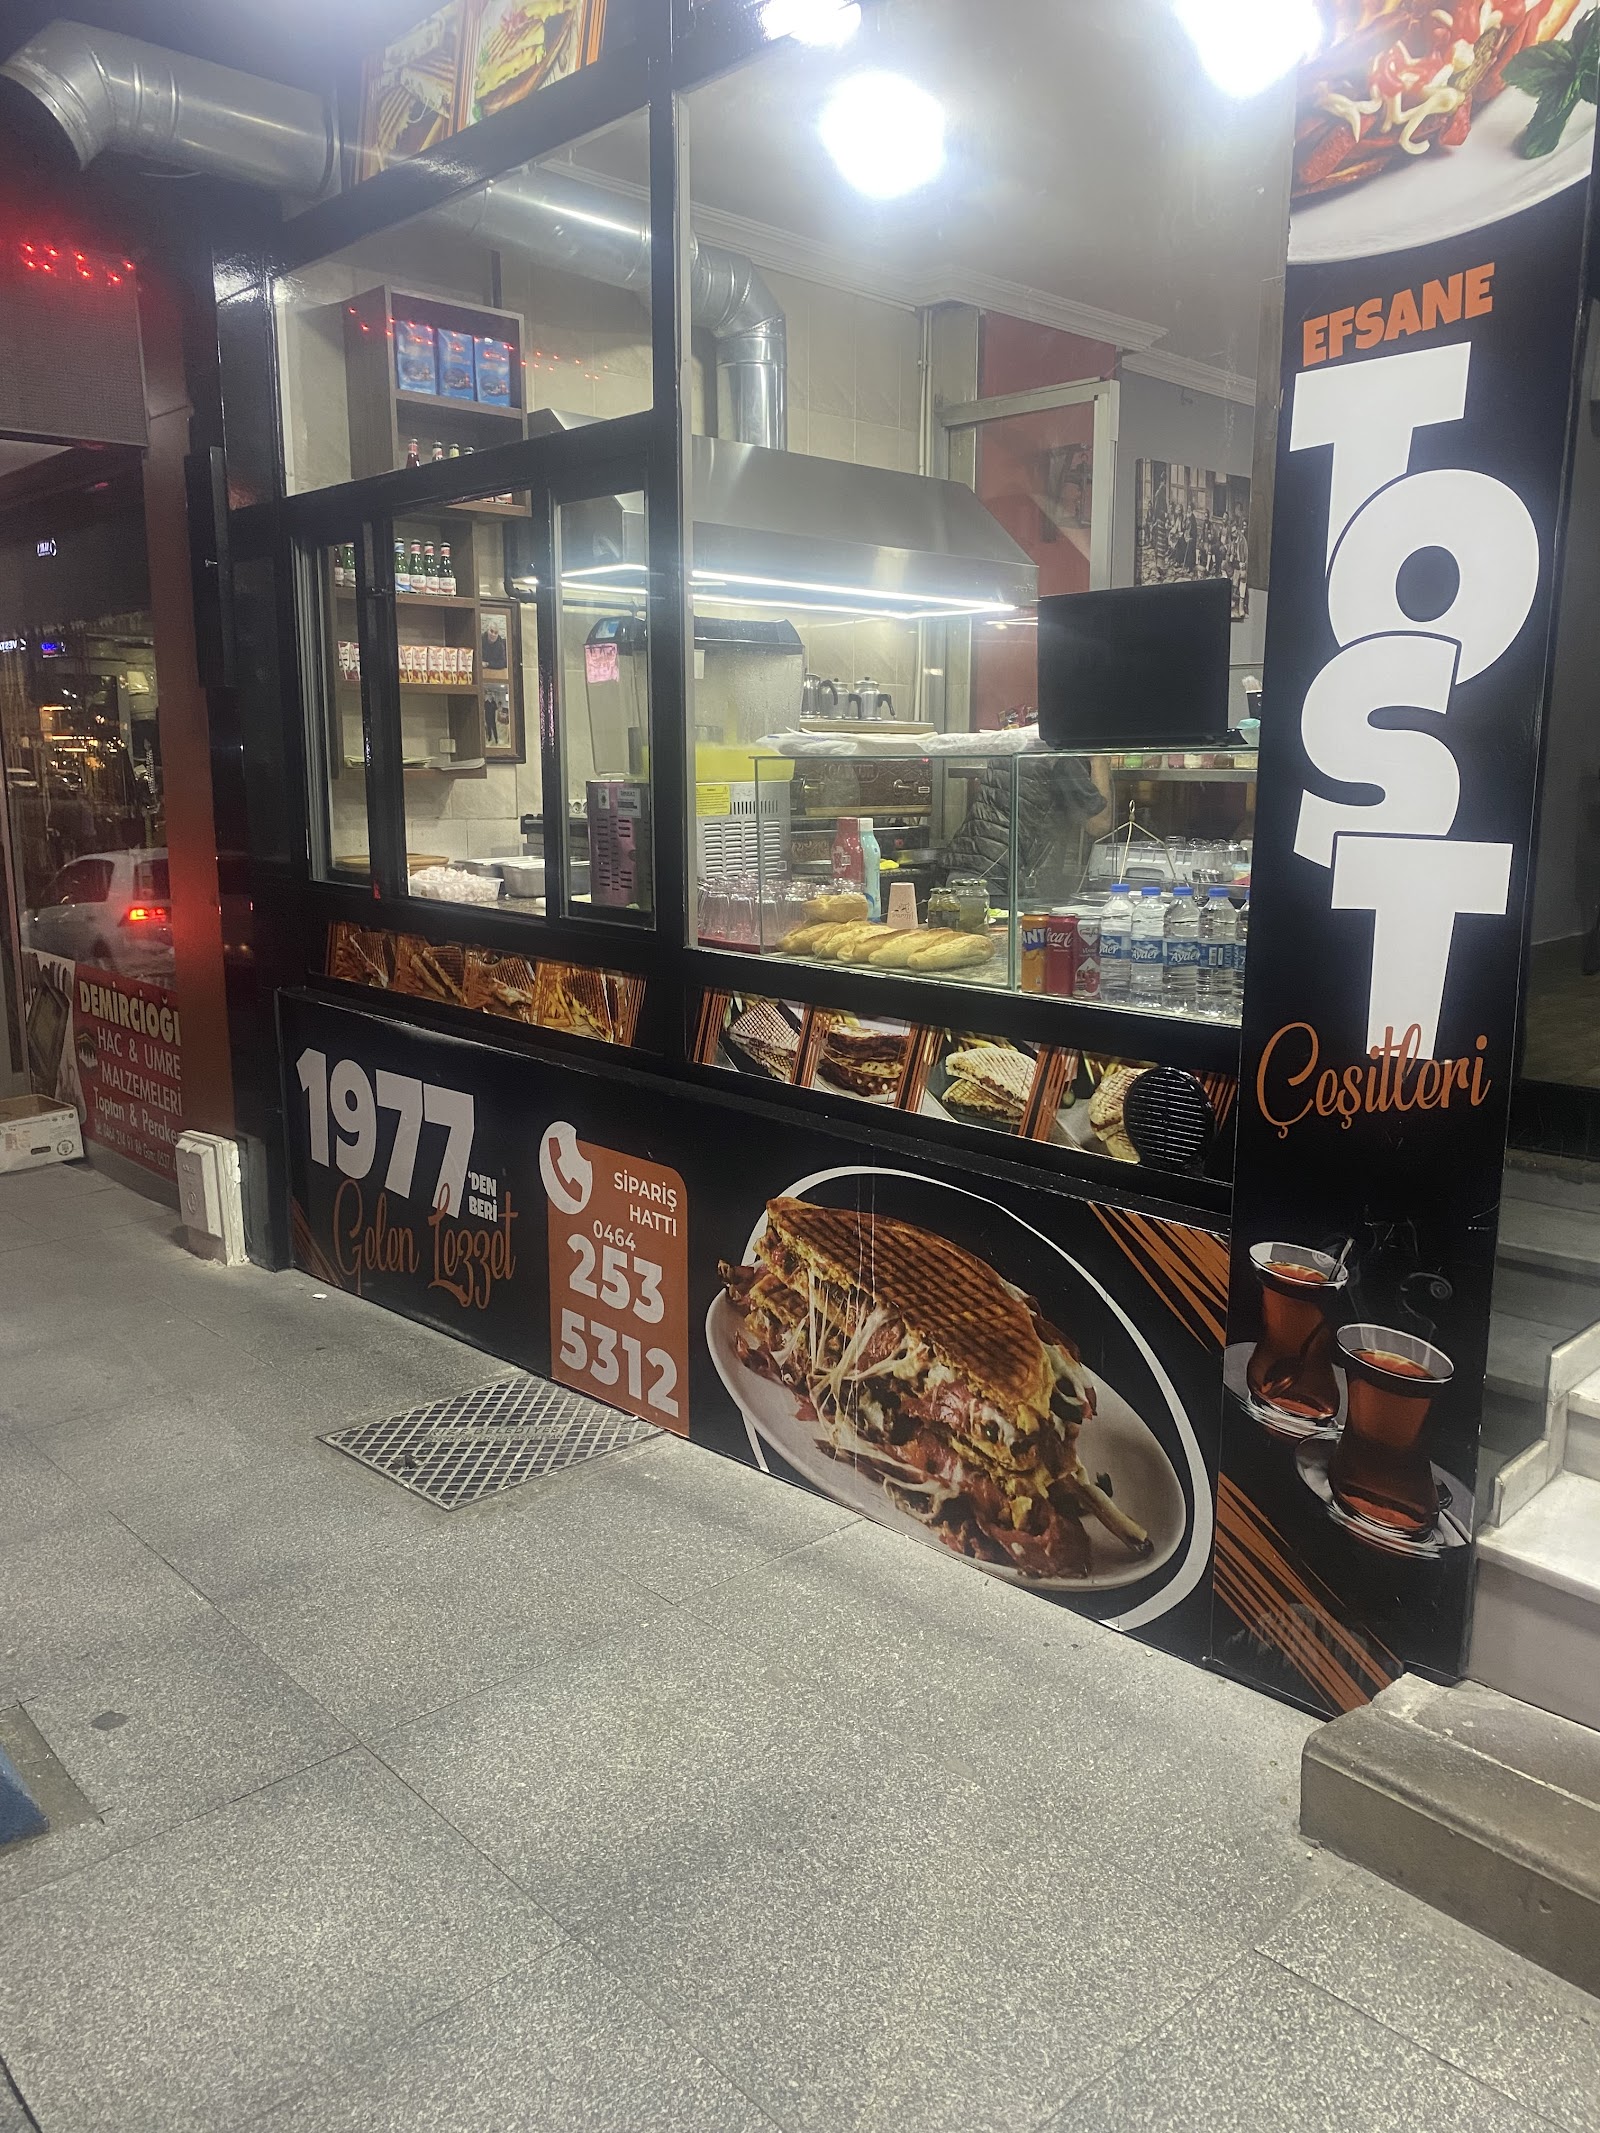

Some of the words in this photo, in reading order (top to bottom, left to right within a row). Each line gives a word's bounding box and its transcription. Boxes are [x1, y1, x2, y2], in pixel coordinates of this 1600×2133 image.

[1302, 262, 1495, 367] EFSANE
[1290, 342, 1539, 1060] TOST
[97, 1027, 123, 1057] HAC
[128, 1038, 139, 1064] &
[144, 1044, 182, 1081] UMRE
[101, 1060, 182, 1117] MALZEMELERİ
[1257, 1022, 1491, 1139] Çeşitleri
[93, 1086, 126, 1122] Toptan
[129, 1103, 138, 1128] &
[296, 1048, 475, 1219] 1977
[468, 1195, 498, 1223] BERİ
[614, 1169, 678, 1213] SİPARİŞ
[629, 1204, 677, 1237] HATTI
[333, 1178, 420, 1296] Gelen
[427, 1182, 518, 1310] Lezzet
[593, 1220, 636, 1252] 0464
[567, 1233, 664, 1324] 253
[559, 1307, 679, 1418] 5312
